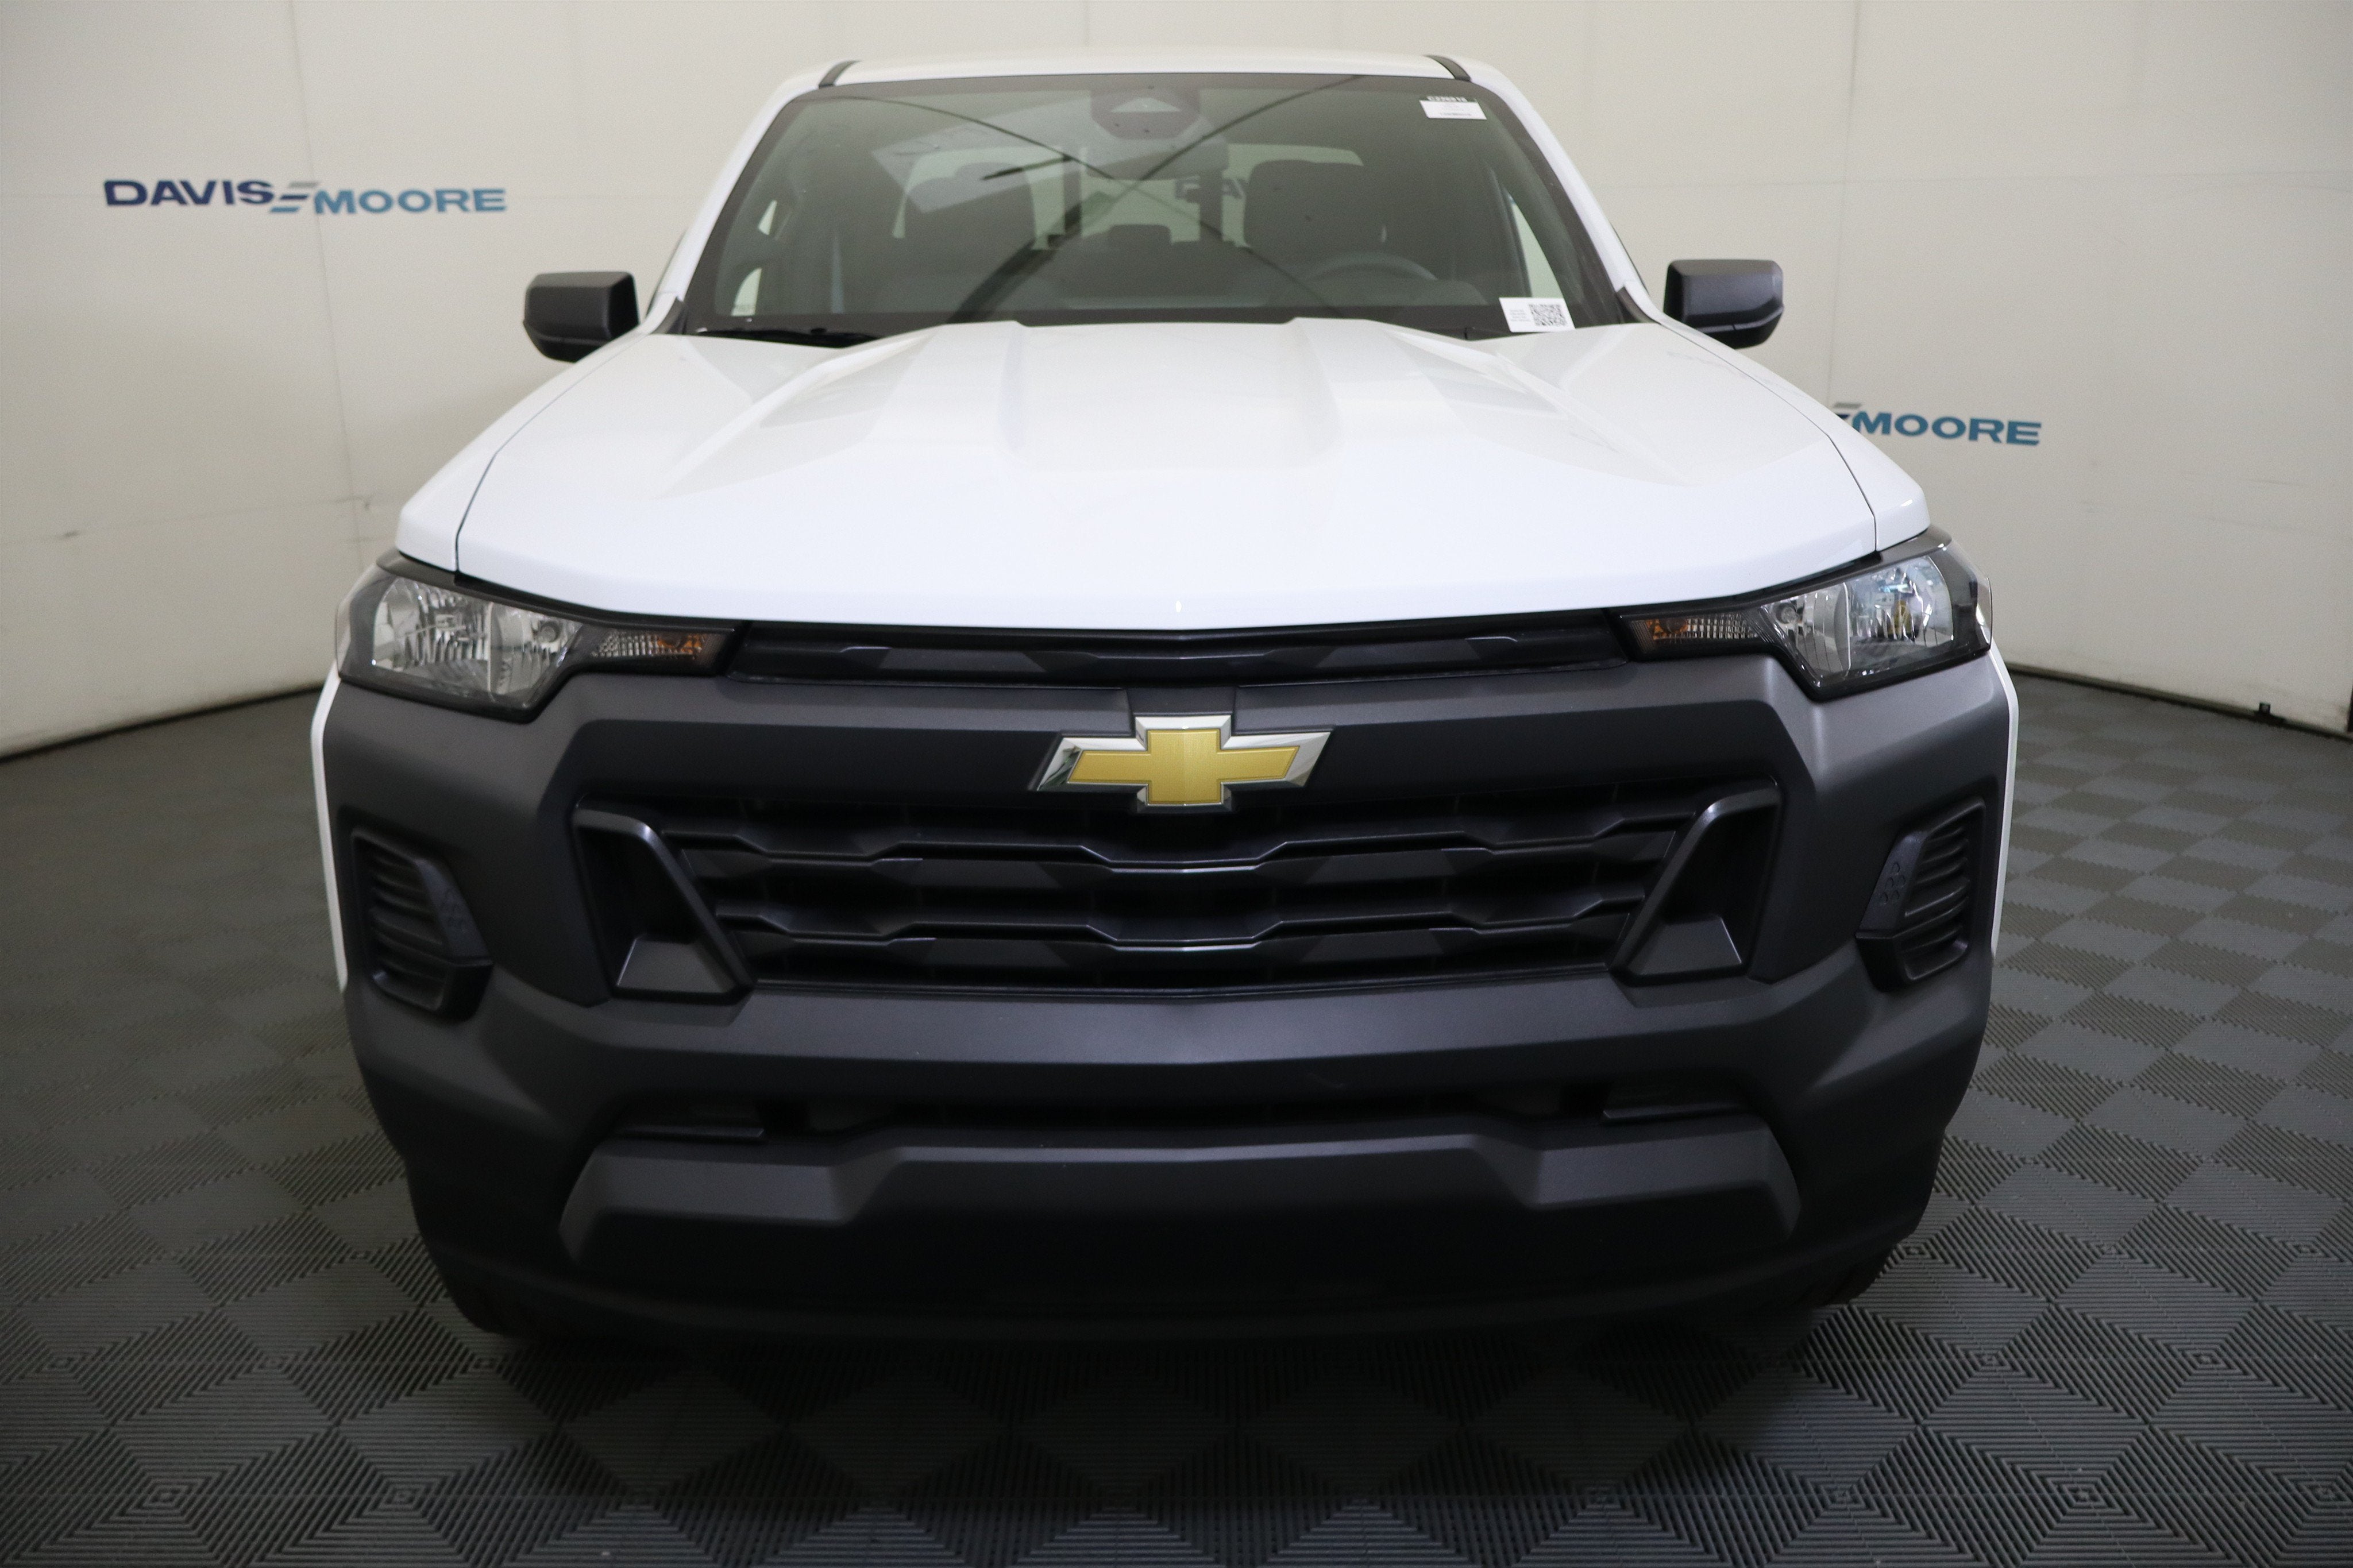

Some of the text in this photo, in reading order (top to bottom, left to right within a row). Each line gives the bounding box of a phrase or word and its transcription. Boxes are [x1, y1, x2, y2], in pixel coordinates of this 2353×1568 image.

[103, 179, 506, 215] DAVIS MOORE
[1851, 410, 2042, 447] MOORE
